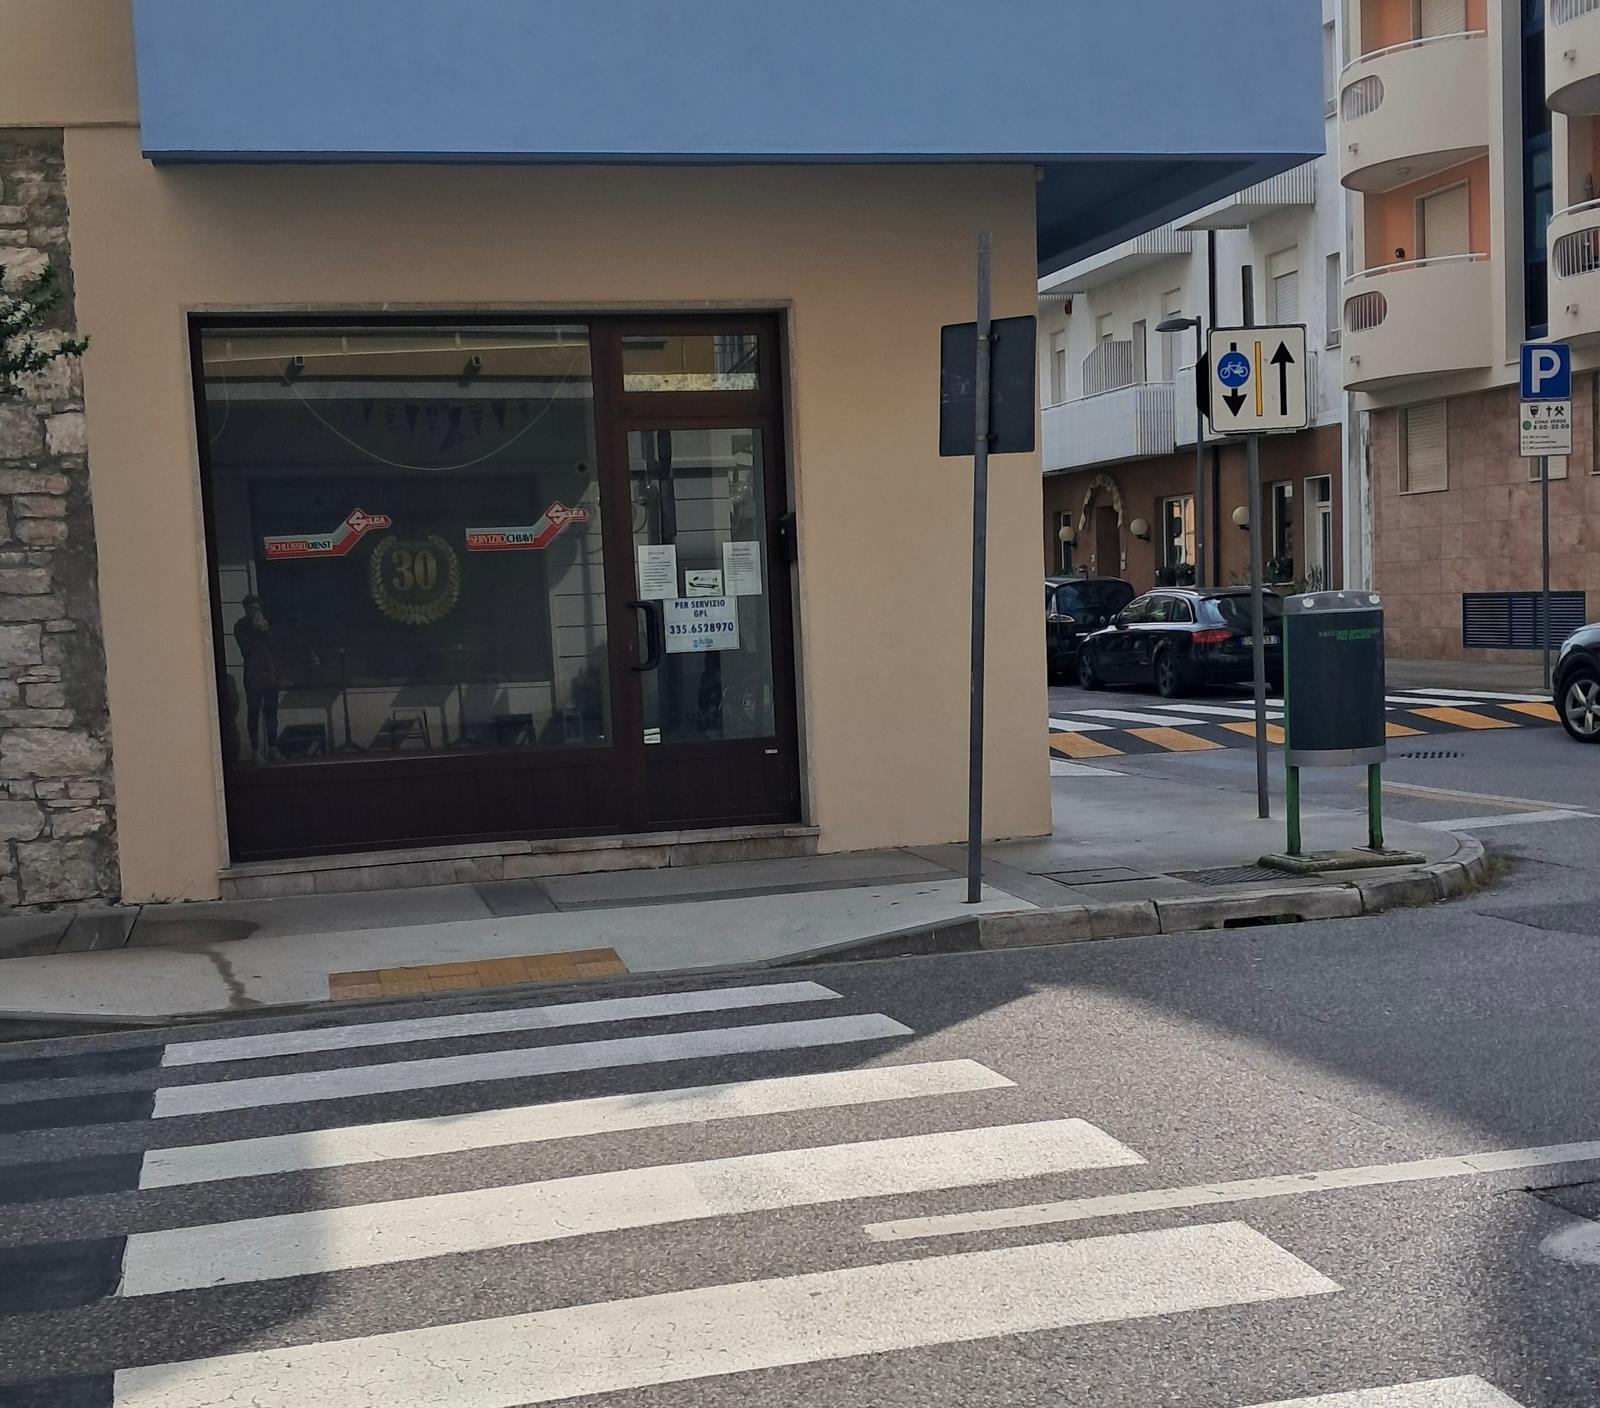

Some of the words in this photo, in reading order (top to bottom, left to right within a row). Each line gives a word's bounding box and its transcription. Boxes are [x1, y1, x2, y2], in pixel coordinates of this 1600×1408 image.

[1531, 349, 1561, 393] P
[392, 550, 437, 591] 30
[675, 601, 689, 610] PER
[691, 600, 725, 608] SERVIZIO
[693, 609, 708, 618] GPL
[669, 622, 734, 635] 335.6528970
